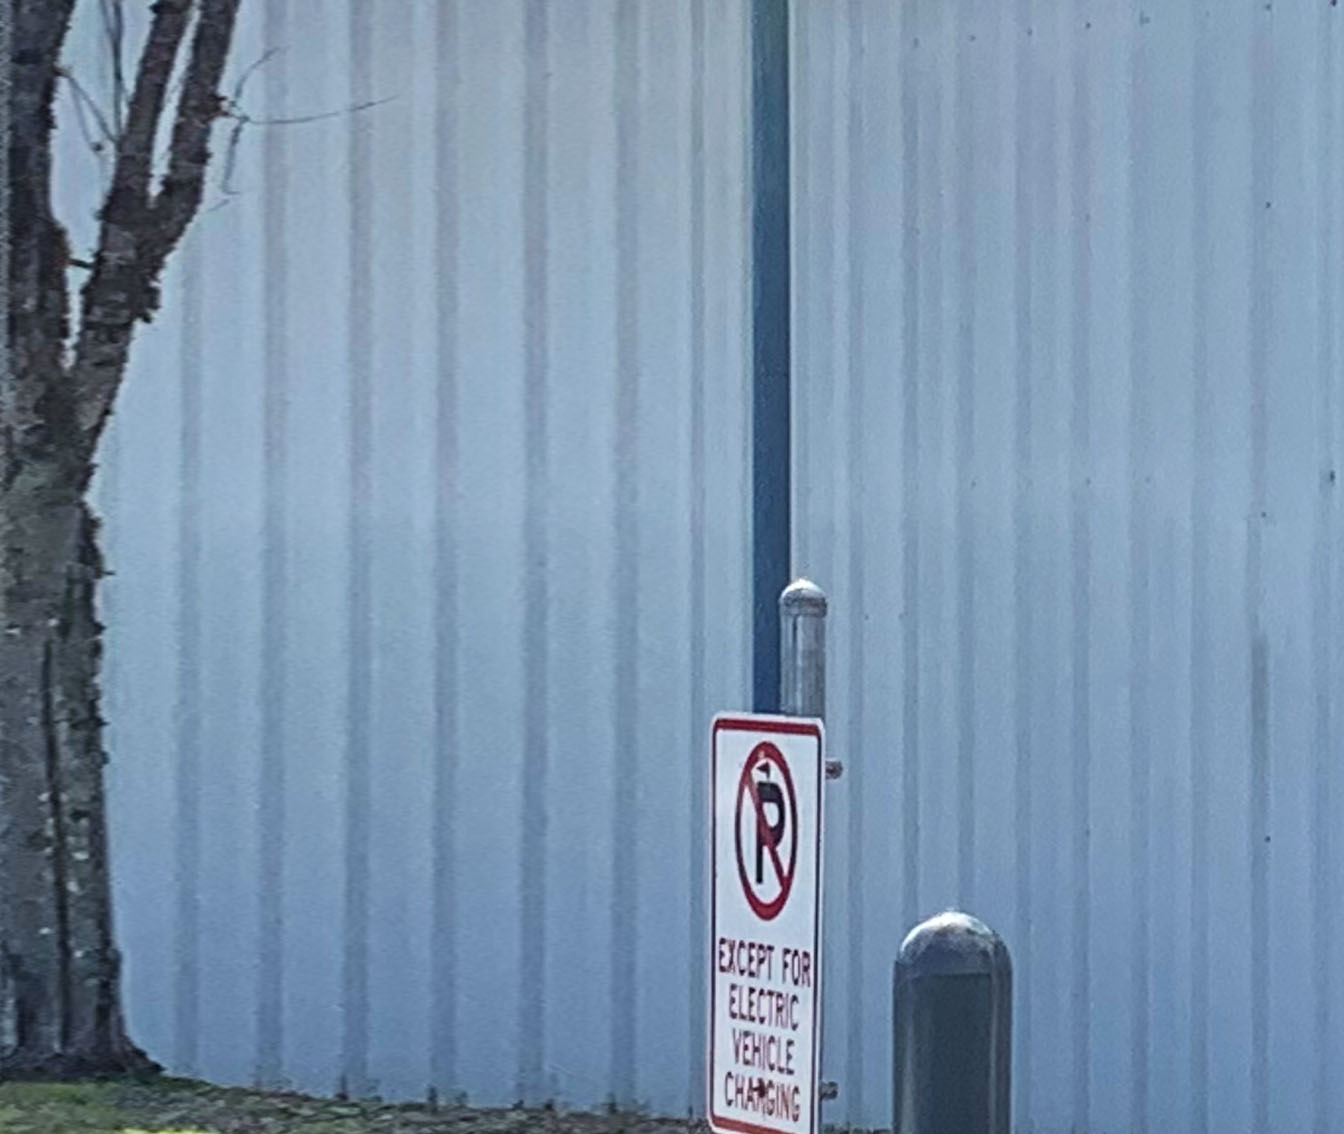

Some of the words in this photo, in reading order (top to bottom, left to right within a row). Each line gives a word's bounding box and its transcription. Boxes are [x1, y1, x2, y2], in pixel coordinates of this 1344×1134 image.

[718, 937, 775, 981] EXCEPT
[782, 947, 812, 988] FOR
[728, 983, 800, 1032] ELECTRIC
[732, 1028, 795, 1076] VEHICLE
[724, 1071, 801, 1123] CHARGING
